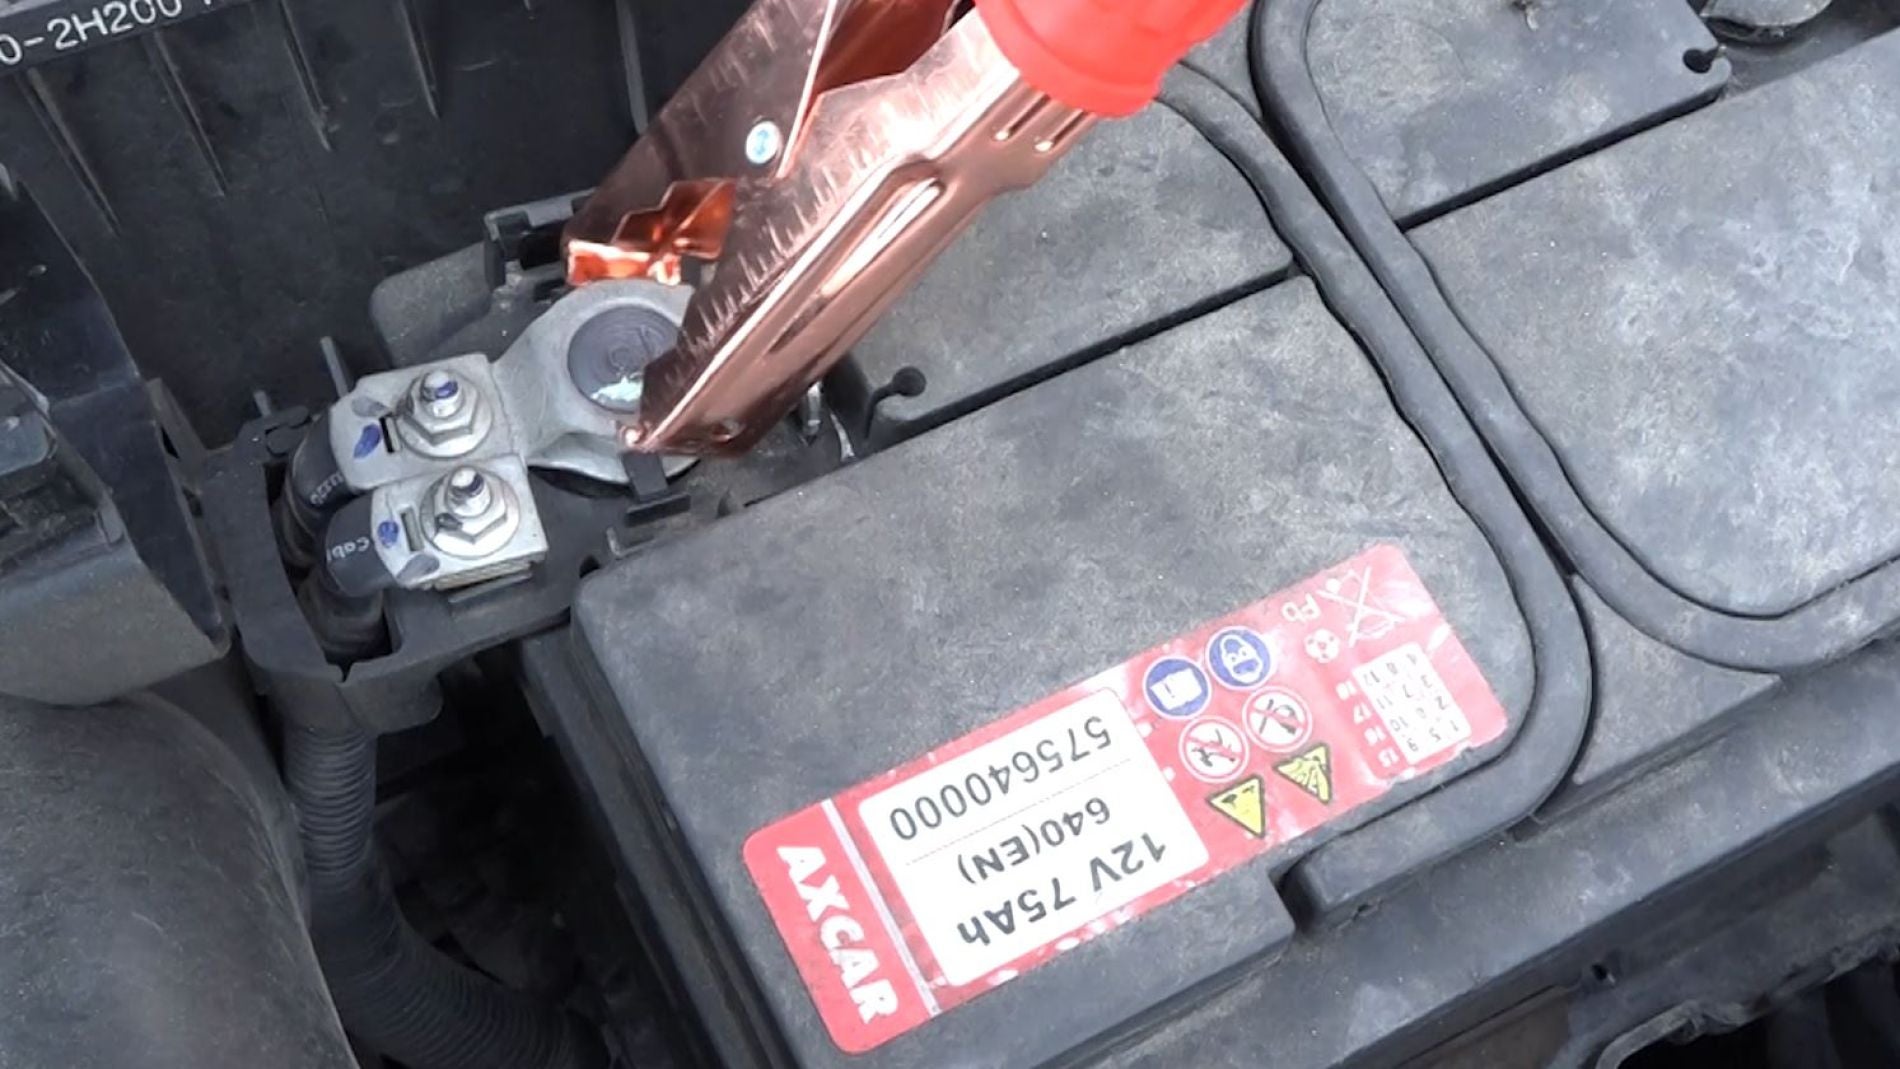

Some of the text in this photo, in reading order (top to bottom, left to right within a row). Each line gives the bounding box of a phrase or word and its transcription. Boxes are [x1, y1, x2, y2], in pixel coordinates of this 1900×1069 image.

[1354, 702, 1373, 724] 17
[1436, 695, 1446, 711] 2
[1391, 716, 1408, 732] 10
[1429, 727, 1442, 741] 5
[1406, 736, 1419, 752] 9
[888, 714, 1112, 841] 575640000
[956, 796, 1112, 884] 640(EN)
[956, 832, 1167, 946] 12V 75Ah
[777, 845, 897, 1024] AXCAR
